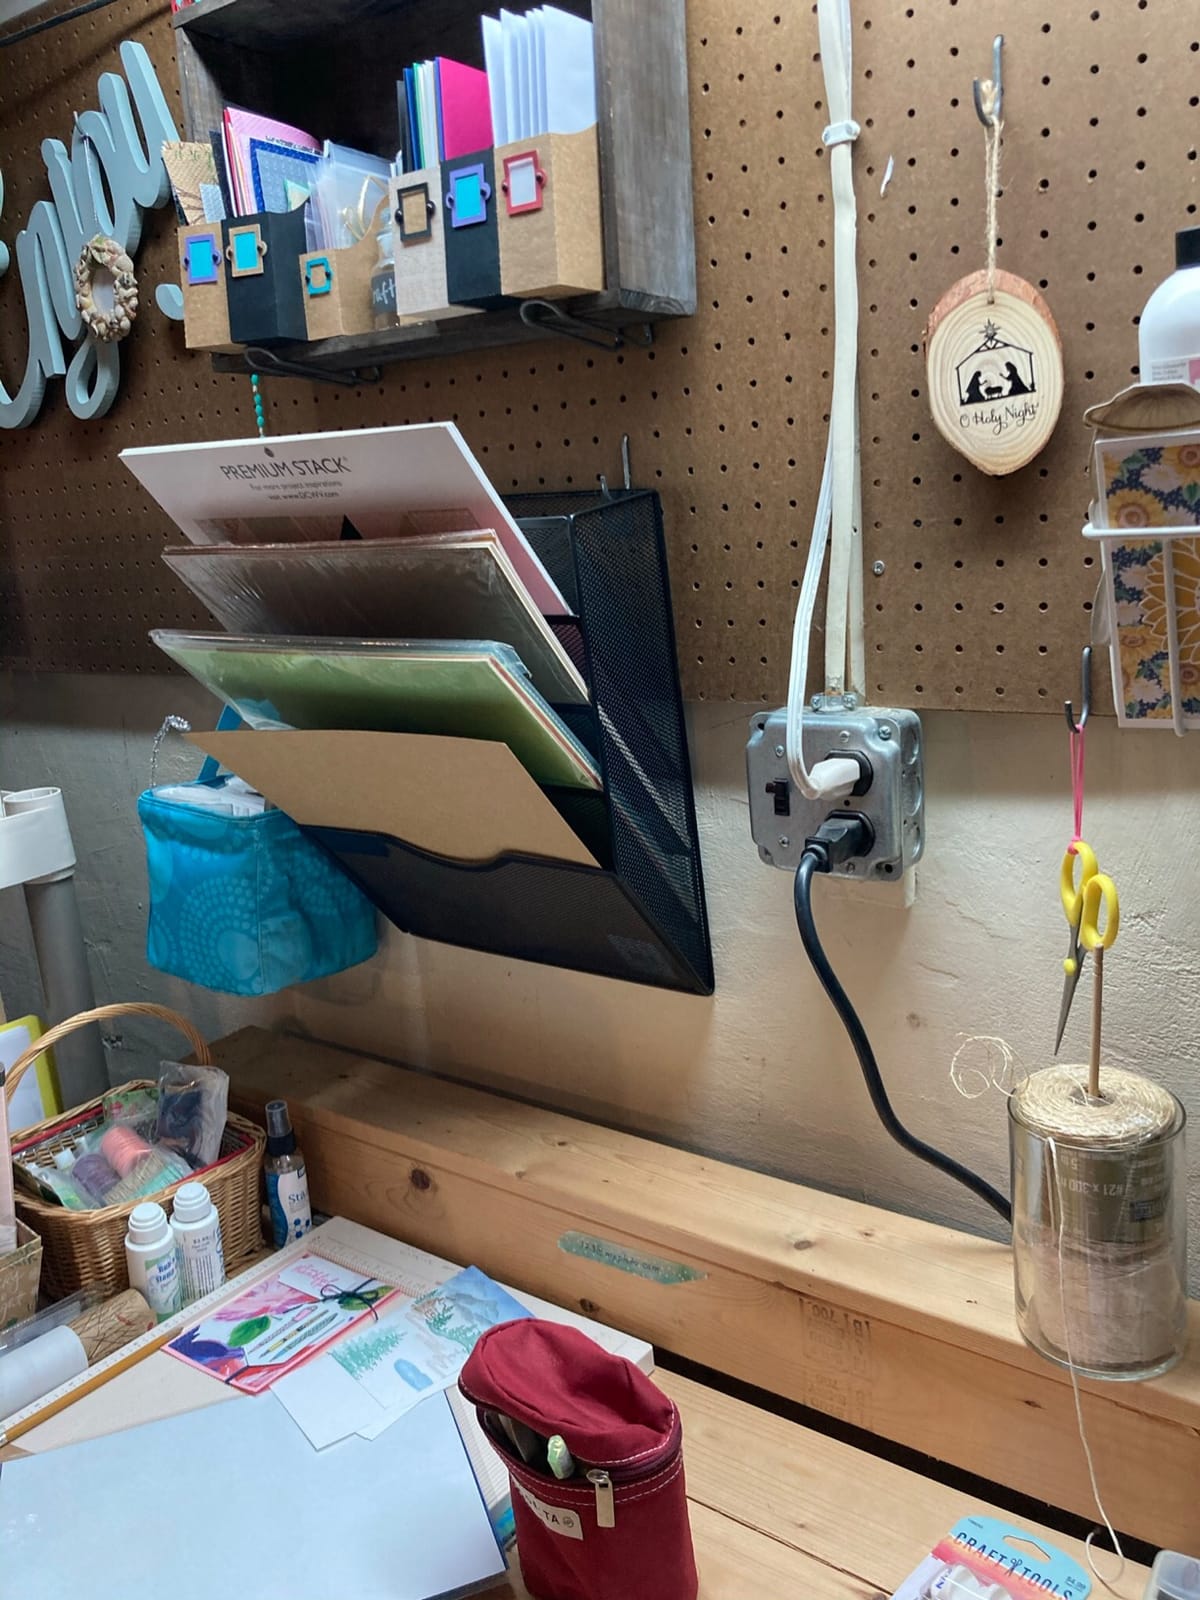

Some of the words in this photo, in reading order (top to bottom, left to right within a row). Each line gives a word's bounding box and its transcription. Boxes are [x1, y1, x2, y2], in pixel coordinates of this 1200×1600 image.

[959, 413, 970, 428] O
[973, 408, 1008, 435] Holy
[1005, 402, 1039, 427] Night
[219, 461, 294, 480] PREMIUM
[953, 1531, 1009, 1567] CRAFT
[1016, 1566, 1074, 1600] TOOLS
